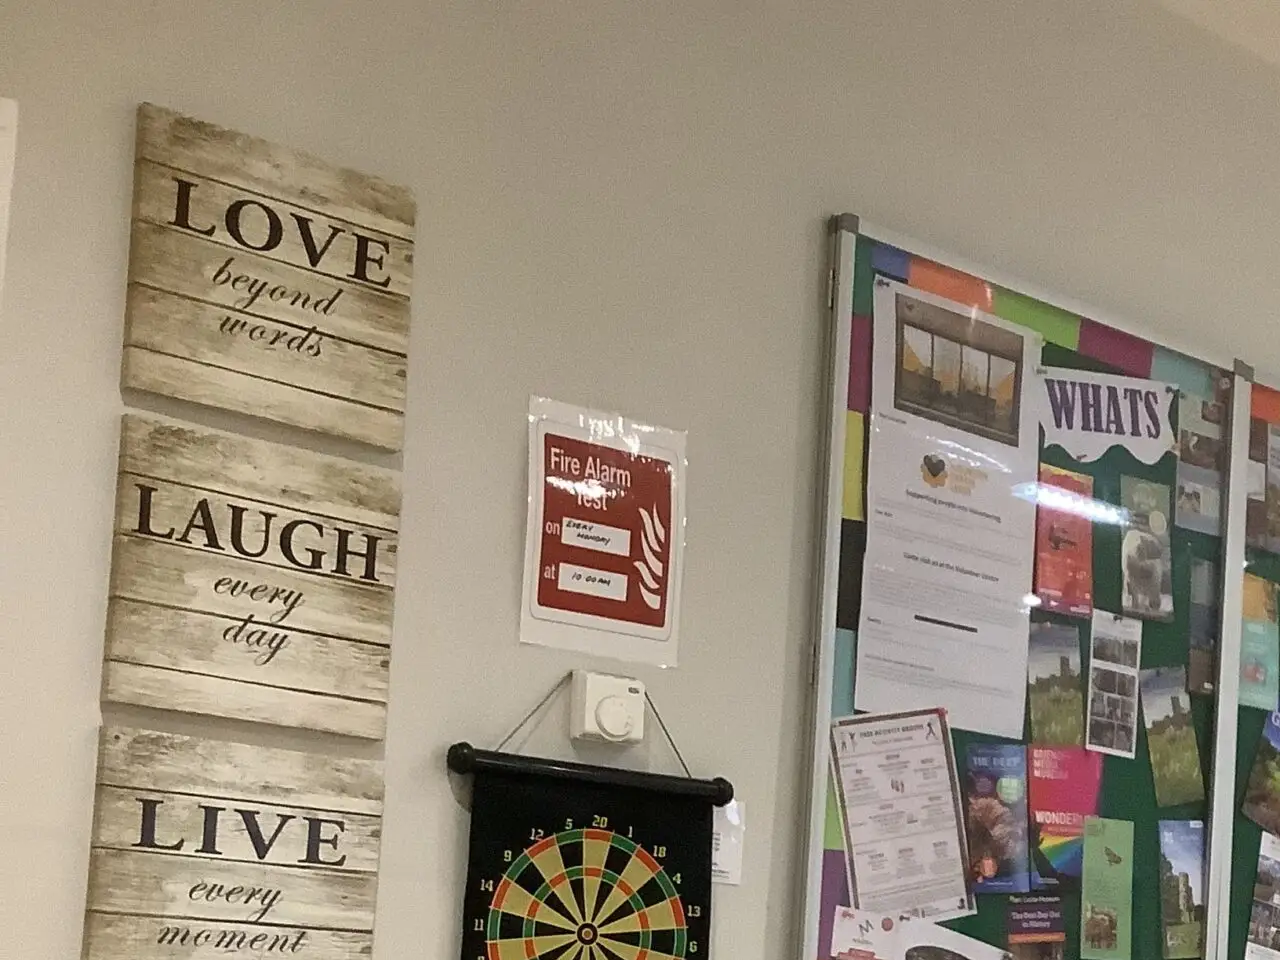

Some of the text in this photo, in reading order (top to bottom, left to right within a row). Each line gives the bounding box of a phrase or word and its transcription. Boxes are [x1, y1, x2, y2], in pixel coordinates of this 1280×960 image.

[167, 177, 392, 288] LOVE
[212, 257, 343, 316] beyond
[219, 314, 322, 358] words
[1044, 378, 1161, 440] WHATS
[550, 447, 631, 487] Fire Alarm
[131, 483, 382, 582] LAUGH
[545, 522, 561, 536] on
[544, 563, 556, 580] at
[213, 575, 305, 623] every
[222, 614, 291, 665] day
[566, 818, 573, 830] 5
[592, 816, 608, 828] 20
[131, 797, 347, 867] LIVE
[529, 828, 544, 841] 12
[627, 826, 634, 838] 1
[504, 850, 512, 862] 9
[653, 845, 666, 858] 18
[480, 879, 494, 892] 14
[673, 873, 682, 884] 4
[189, 881, 283, 921] every
[687, 905, 700, 917] 13
[474, 919, 484, 931] 11
[158, 924, 309, 953] moment
[690, 940, 698, 952] 6
